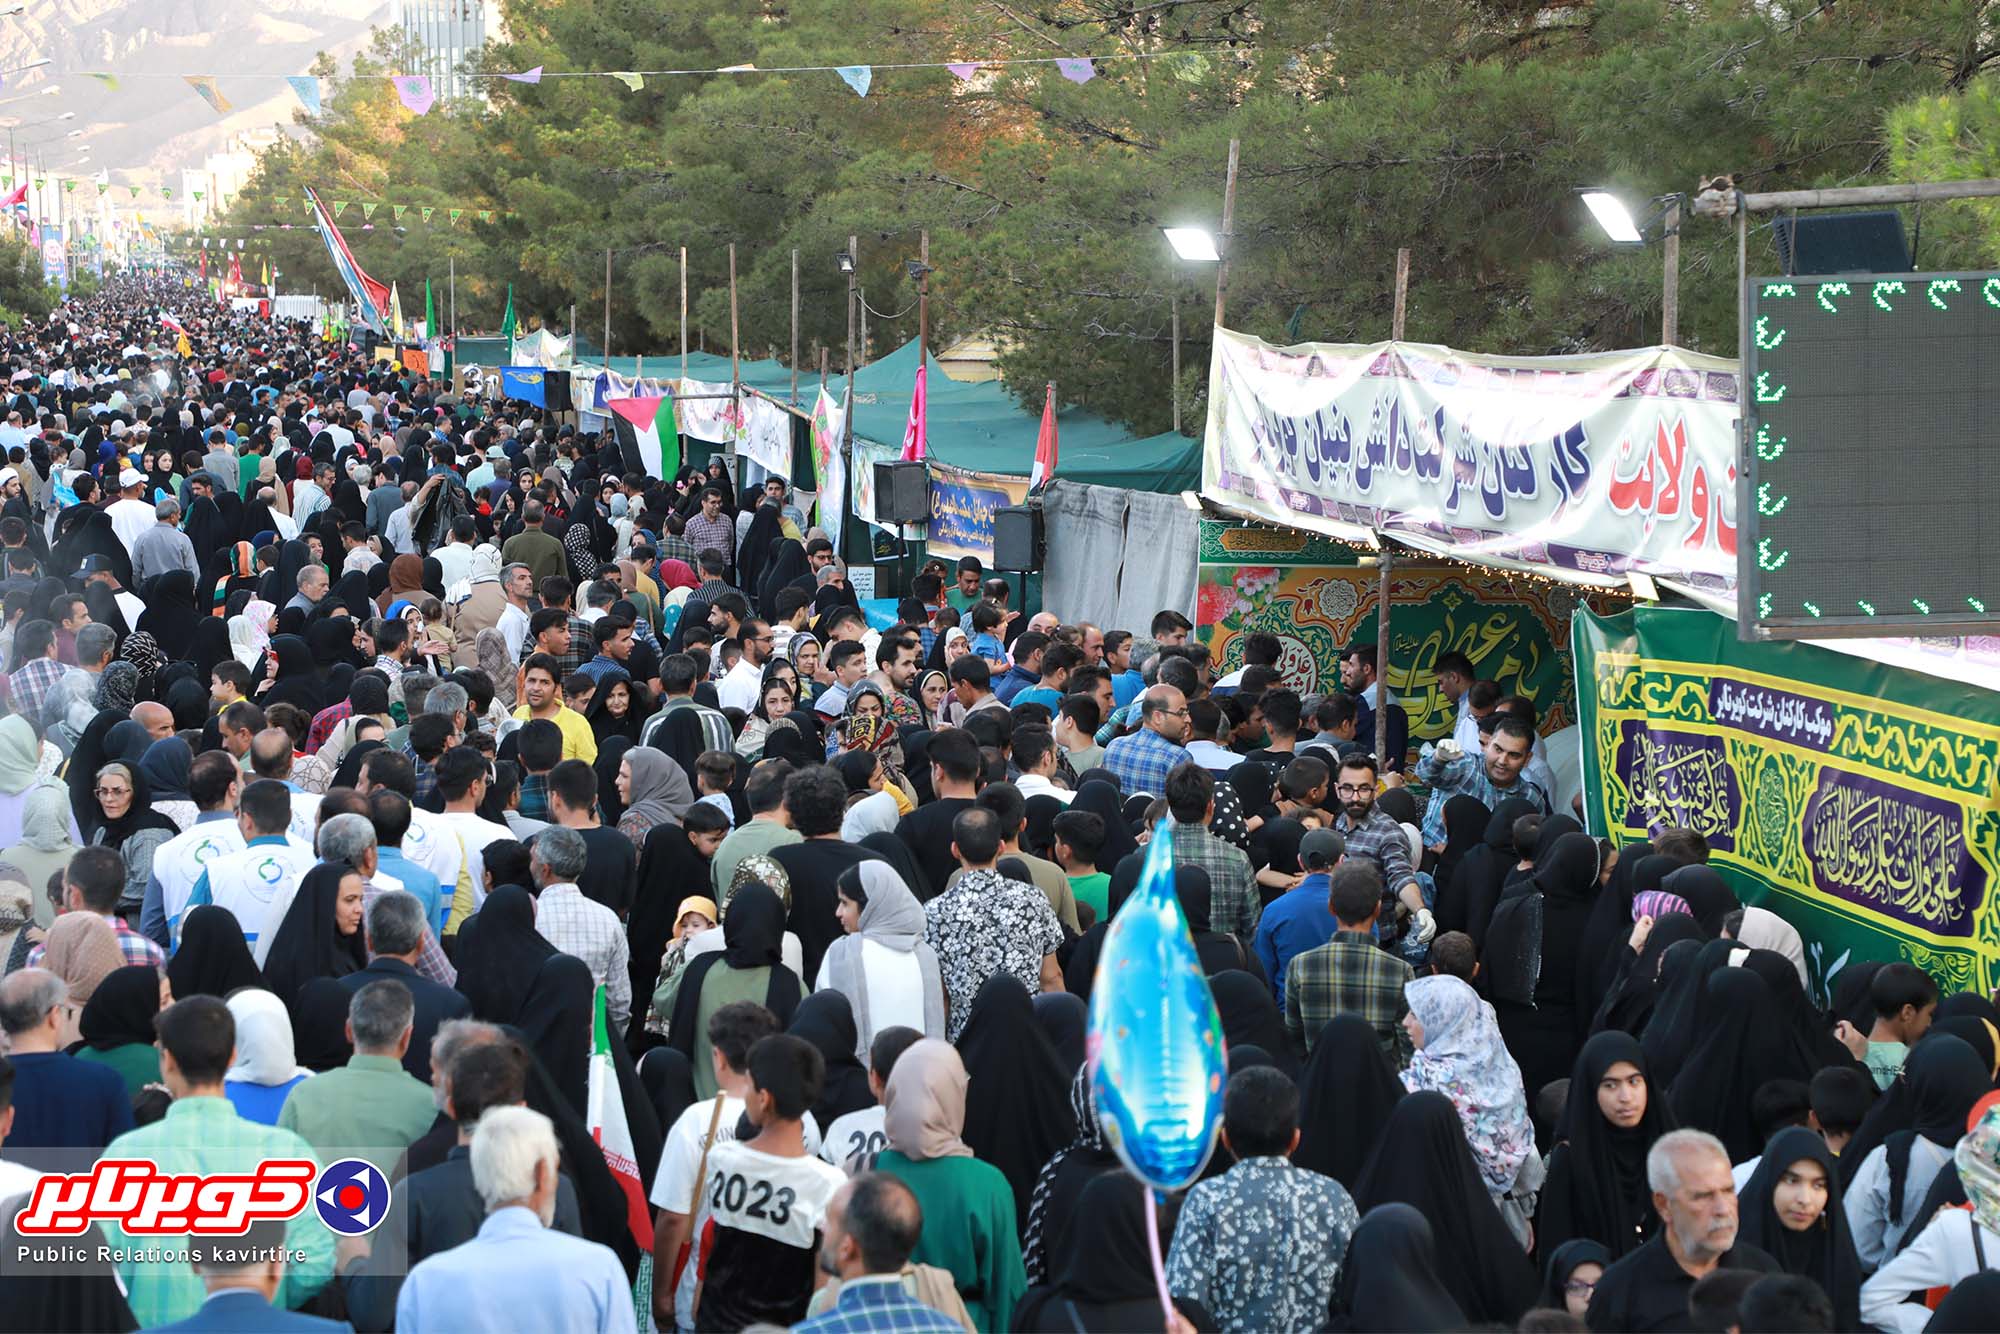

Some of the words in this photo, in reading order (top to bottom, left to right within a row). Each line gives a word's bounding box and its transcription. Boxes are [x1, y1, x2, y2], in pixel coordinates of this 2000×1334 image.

[1303, 402, 1353, 488] بنیان
[1746, 691, 1775, 729] شرکت
[1774, 697, 1806, 738] کارکنان
[1804, 705, 1832, 745] موکب
[711, 1169, 796, 1226] 2023
